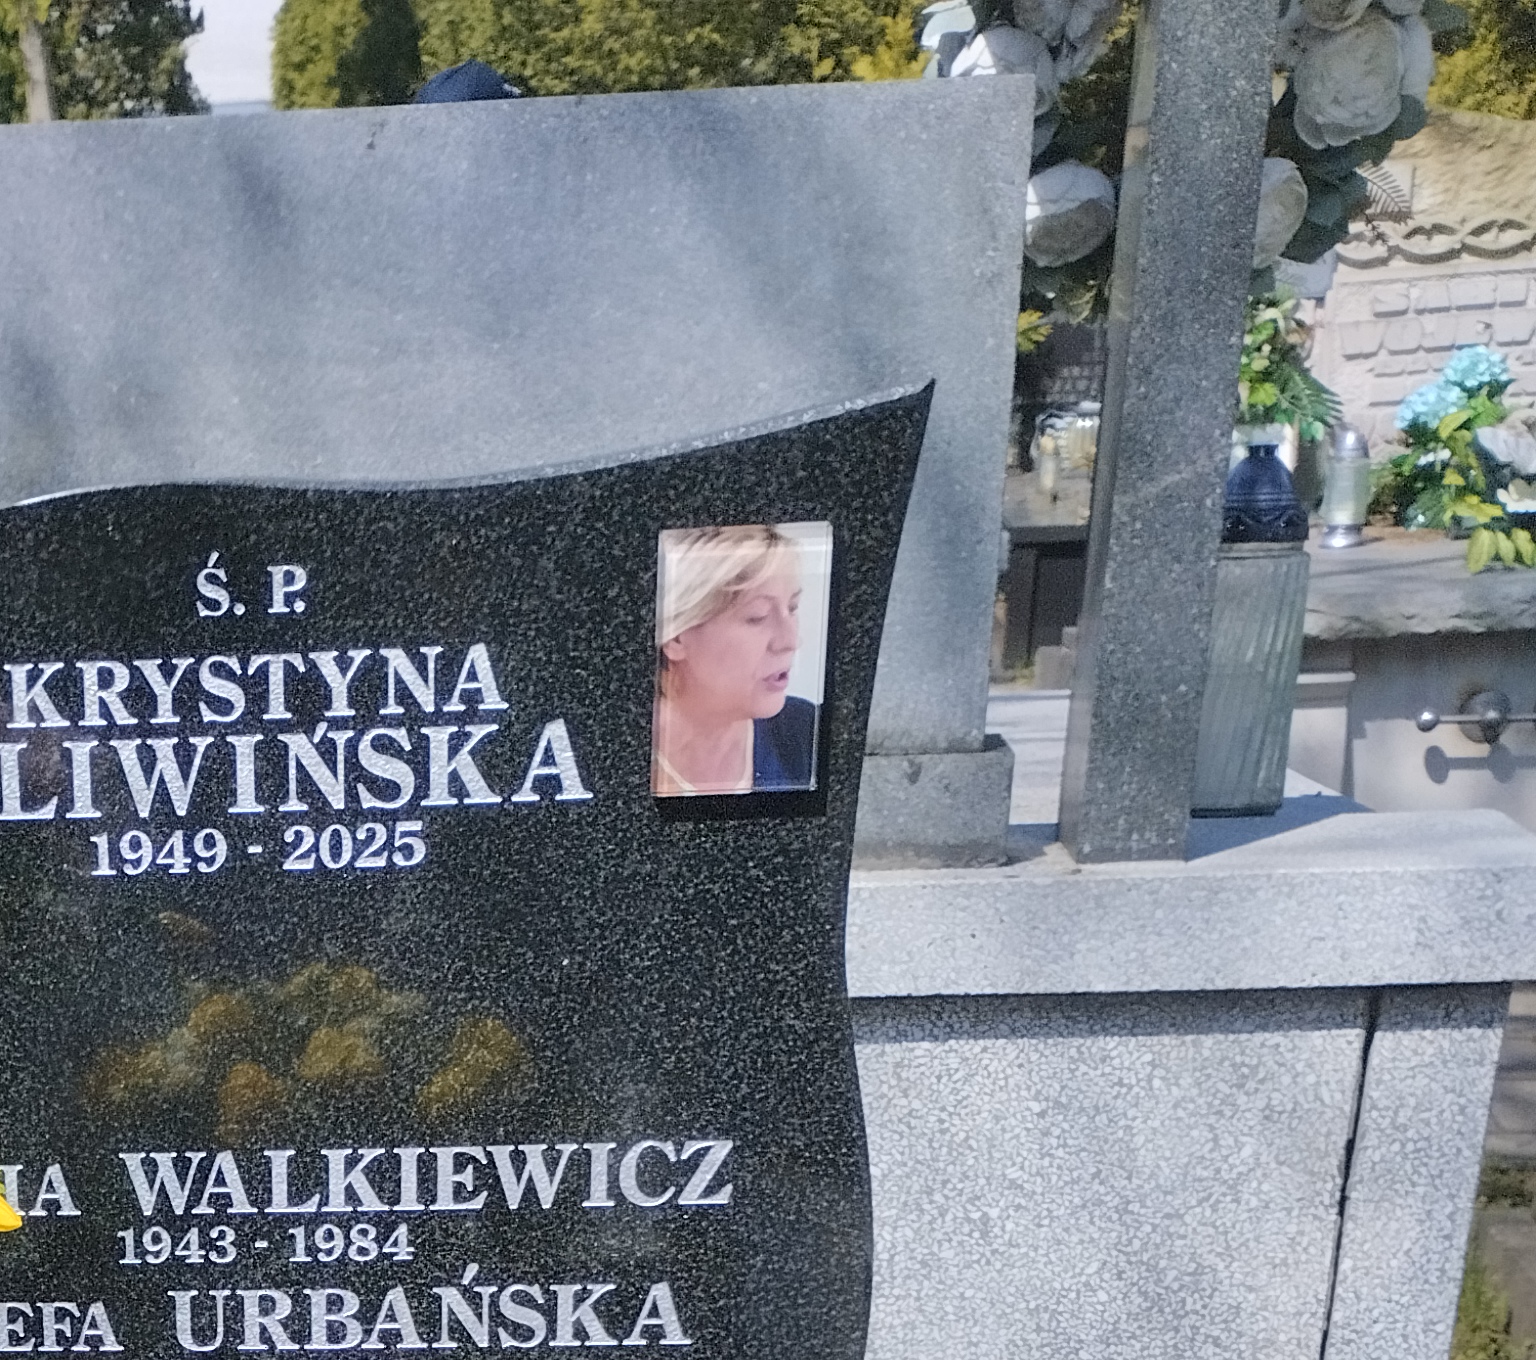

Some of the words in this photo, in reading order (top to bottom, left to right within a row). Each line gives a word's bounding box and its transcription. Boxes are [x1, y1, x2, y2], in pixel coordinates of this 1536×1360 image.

[194, 551, 245, 618] Ś.
[267, 563, 307, 614] P.
[4, 641, 509, 730] KRYSTYNA
[89, 829, 228, 876] 1949
[282, 821, 427, 871] 2025
[119, 1139, 734, 1216] WALKIEWICZ
[117, 1226, 237, 1266] 1943
[287, 1222, 414, 1262] 1984
[167, 1263, 692, 1351] URBAŃSKA
